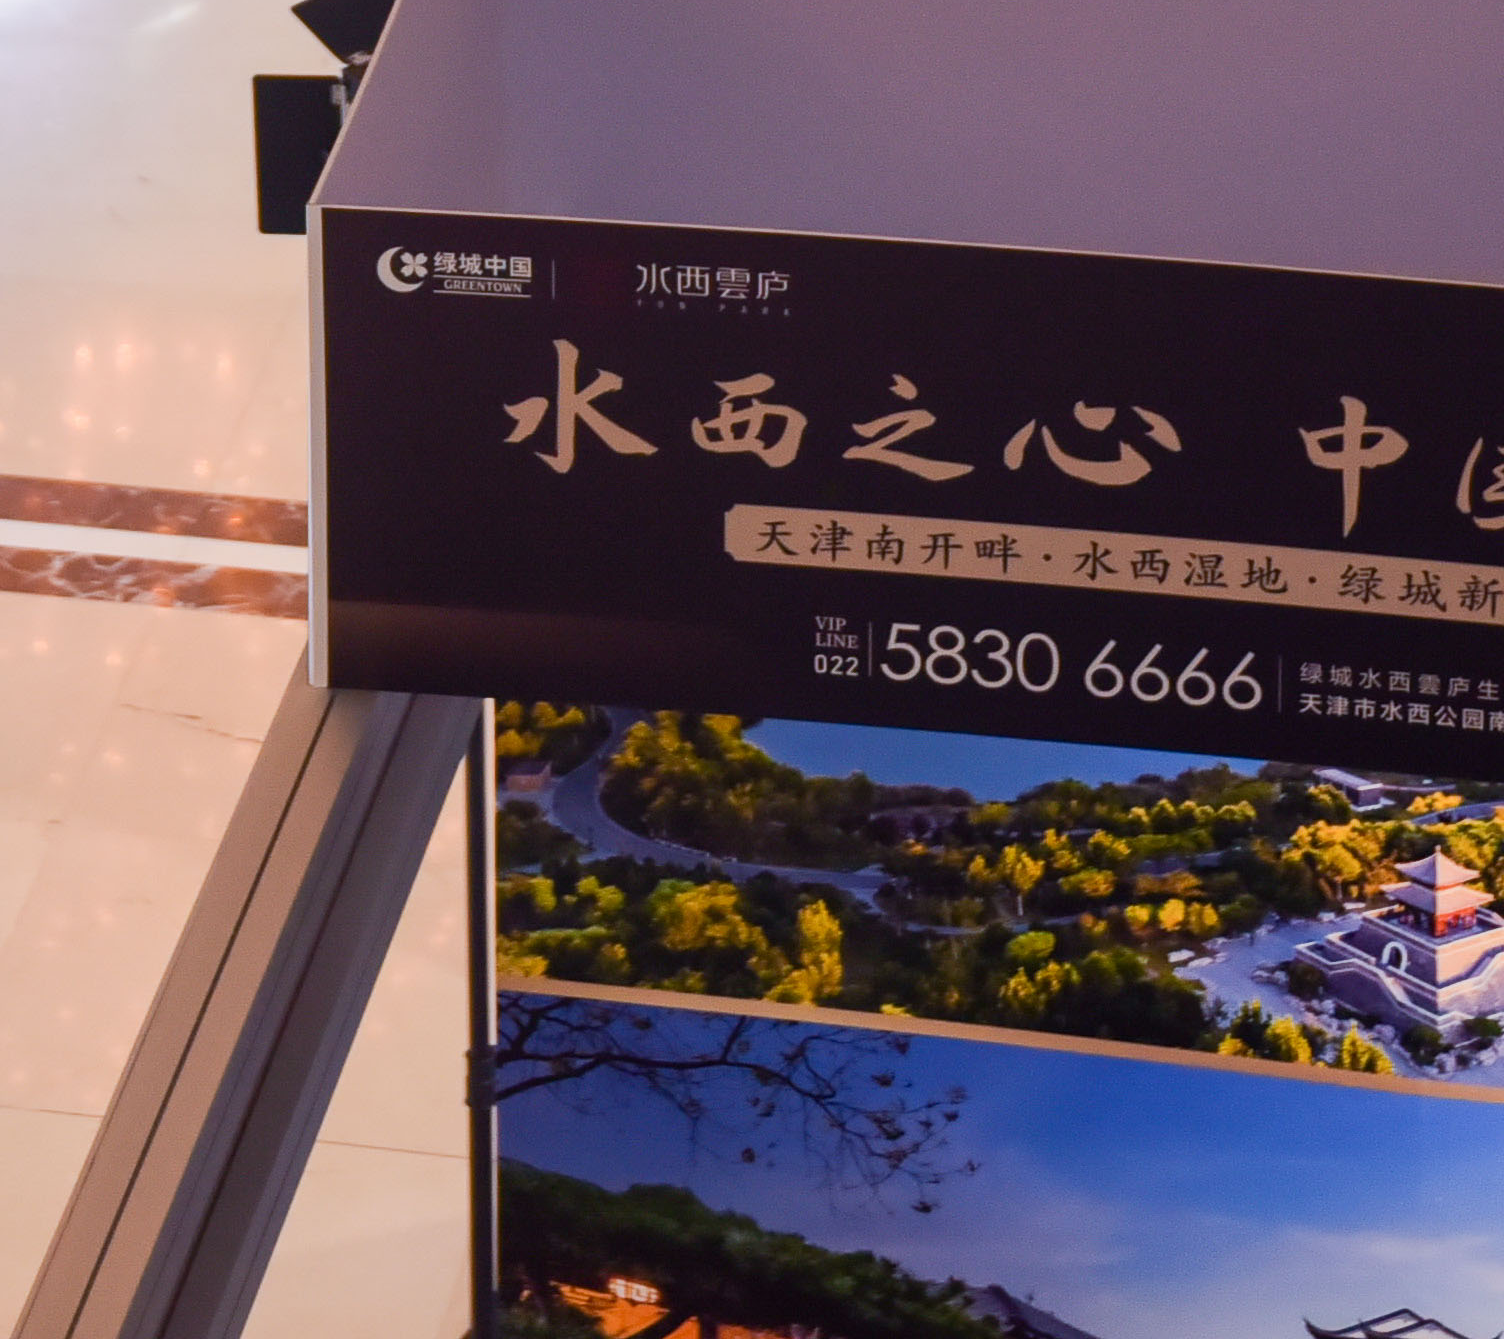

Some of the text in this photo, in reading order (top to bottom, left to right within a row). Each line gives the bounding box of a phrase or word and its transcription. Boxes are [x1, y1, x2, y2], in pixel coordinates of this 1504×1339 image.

[433, 251, 532, 278] 绿城中国
[444, 279, 523, 294] GREENTOWN
[503, 338, 1182, 486] 水西之心
[815, 615, 846, 632] VIP
[815, 631, 859, 649] LINE
[814, 622, 1263, 710] 022 5830 6666
